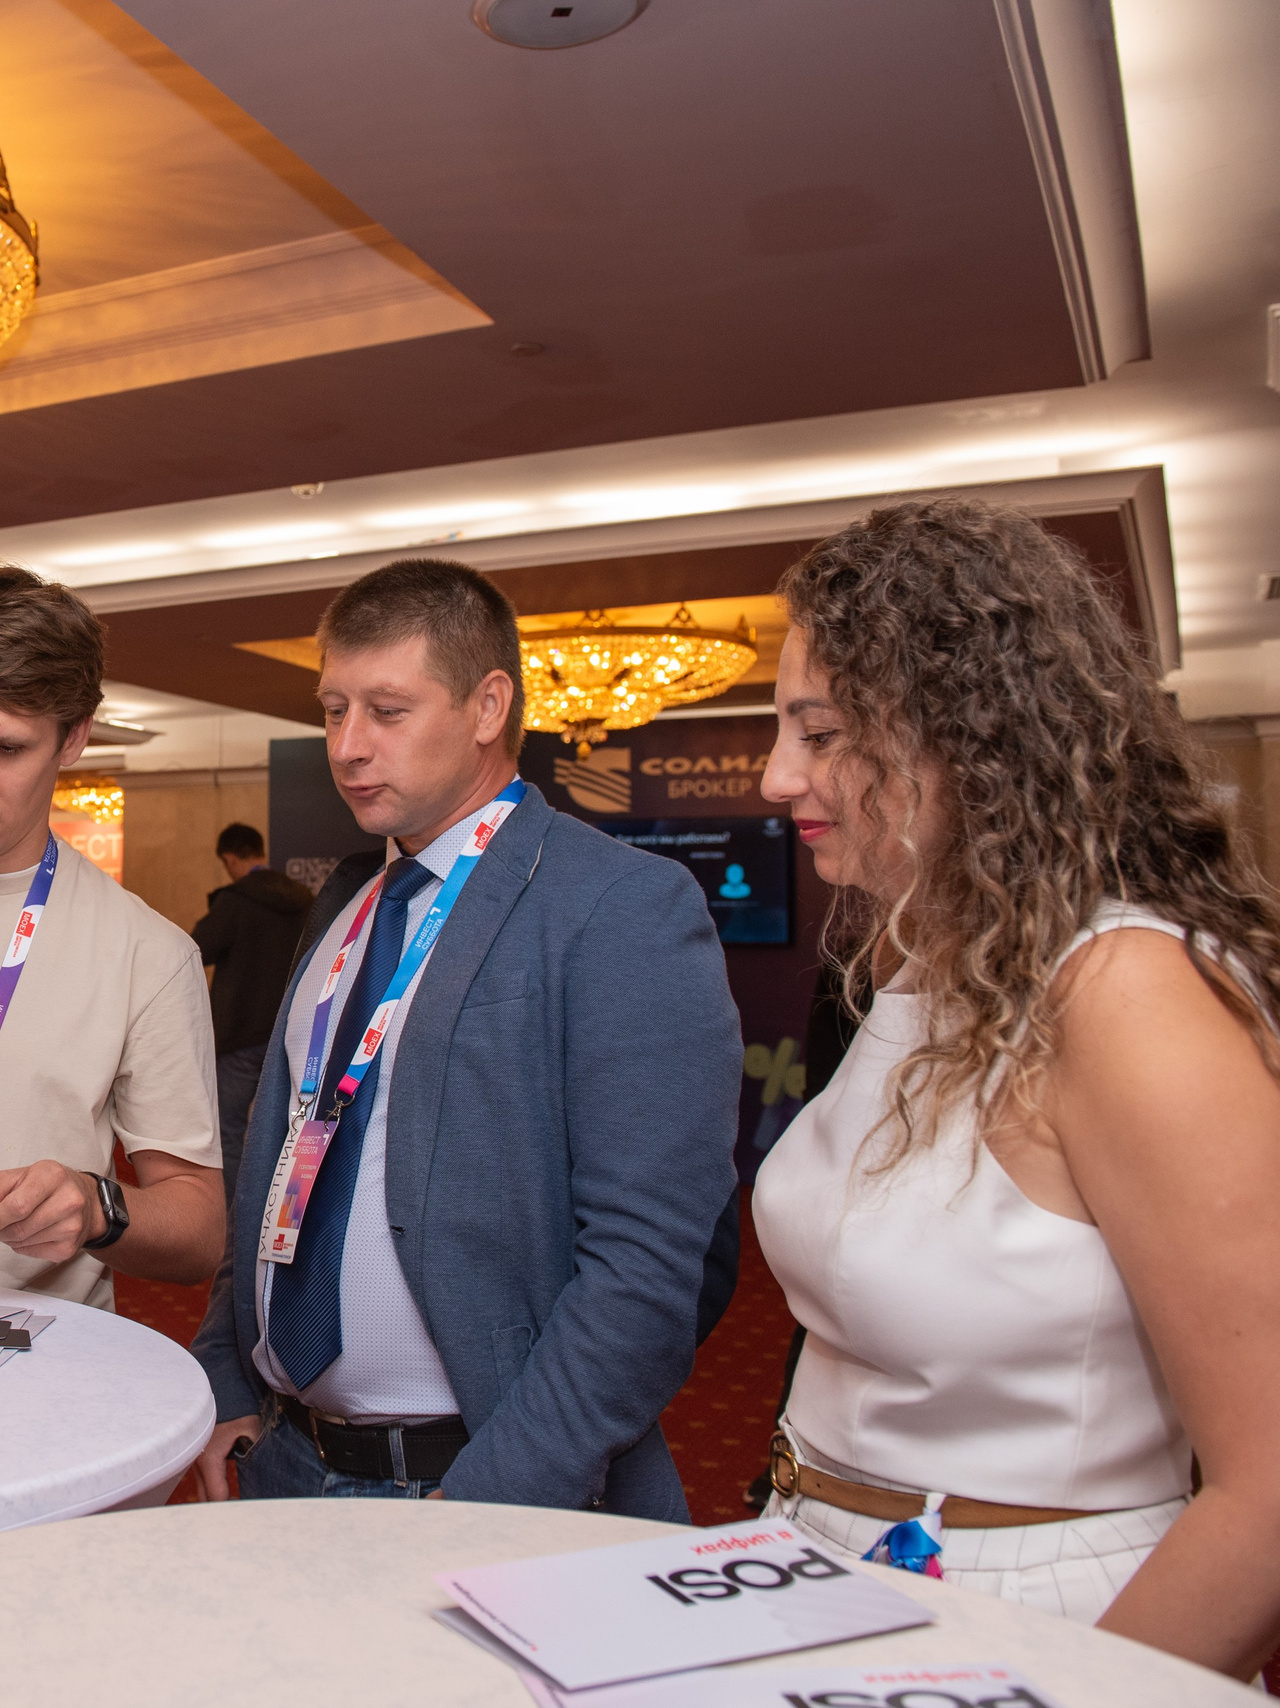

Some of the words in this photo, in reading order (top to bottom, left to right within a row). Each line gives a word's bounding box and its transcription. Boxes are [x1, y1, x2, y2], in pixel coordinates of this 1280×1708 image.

[667, 778, 753, 799] БРОКЕР
[71, 833, 124, 861] ЕСТ
[476, 827, 493, 849] MOEX
[18, 913, 31, 935] MOEX
[415, 917, 435, 948] ИНВЕСТ
[421, 918, 444, 950] СУББОТА
[365, 1032, 381, 1055] MOEX
[259, 1130, 299, 1254] УЧАСТНИК
[689, 1532, 777, 1556] цифрах
[646, 1547, 853, 1606] POSI
